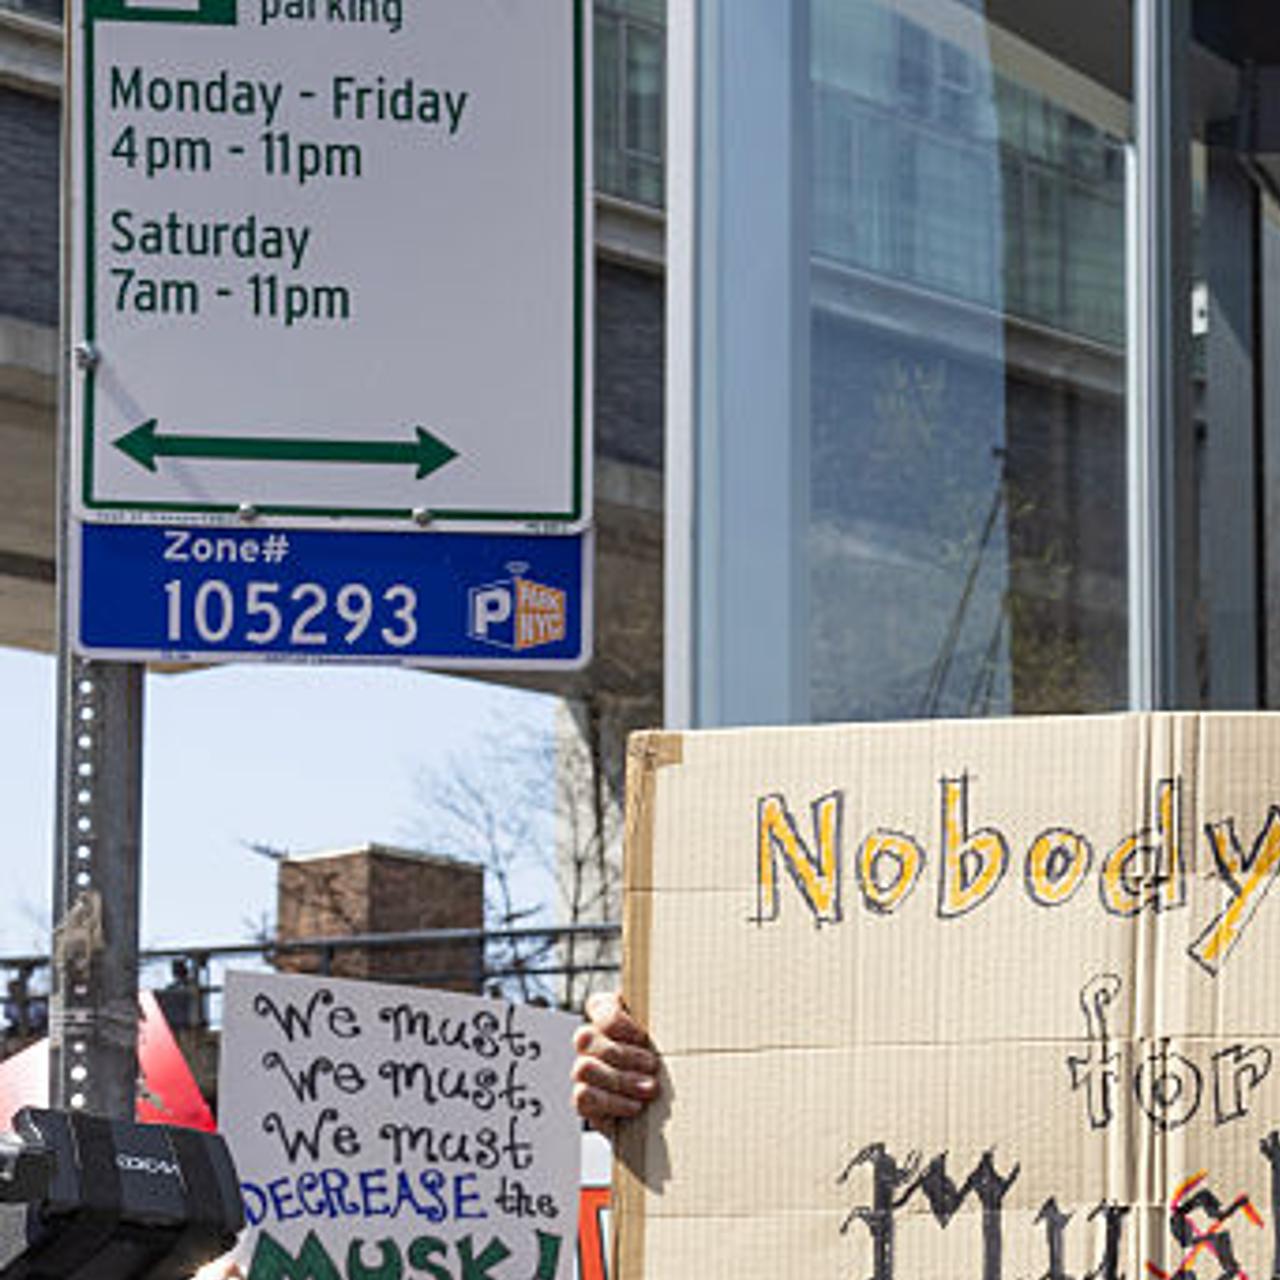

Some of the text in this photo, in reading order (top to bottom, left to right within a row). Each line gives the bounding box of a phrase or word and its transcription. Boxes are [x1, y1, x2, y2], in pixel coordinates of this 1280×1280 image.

[260, 0, 403, 33] parking
[110, 67, 283, 125] Monday
[333, 75, 469, 134] Friday
[111, 127, 211, 178] 4pm
[262, 131, 362, 185] 11pm
[111, 211, 310, 269] Saturday
[111, 269, 198, 314] 7am
[247, 274, 350, 326] 11pm
[164, 530, 289, 562] Zone#
[164, 579, 418, 646] 105293
[253, 988, 541, 1060] We must,
[1068, 974, 1272, 1132] for
[262, 1051, 543, 1117] We must,
[262, 1108, 533, 1170] We must
[240, 1168, 559, 1226] DECREASE the
